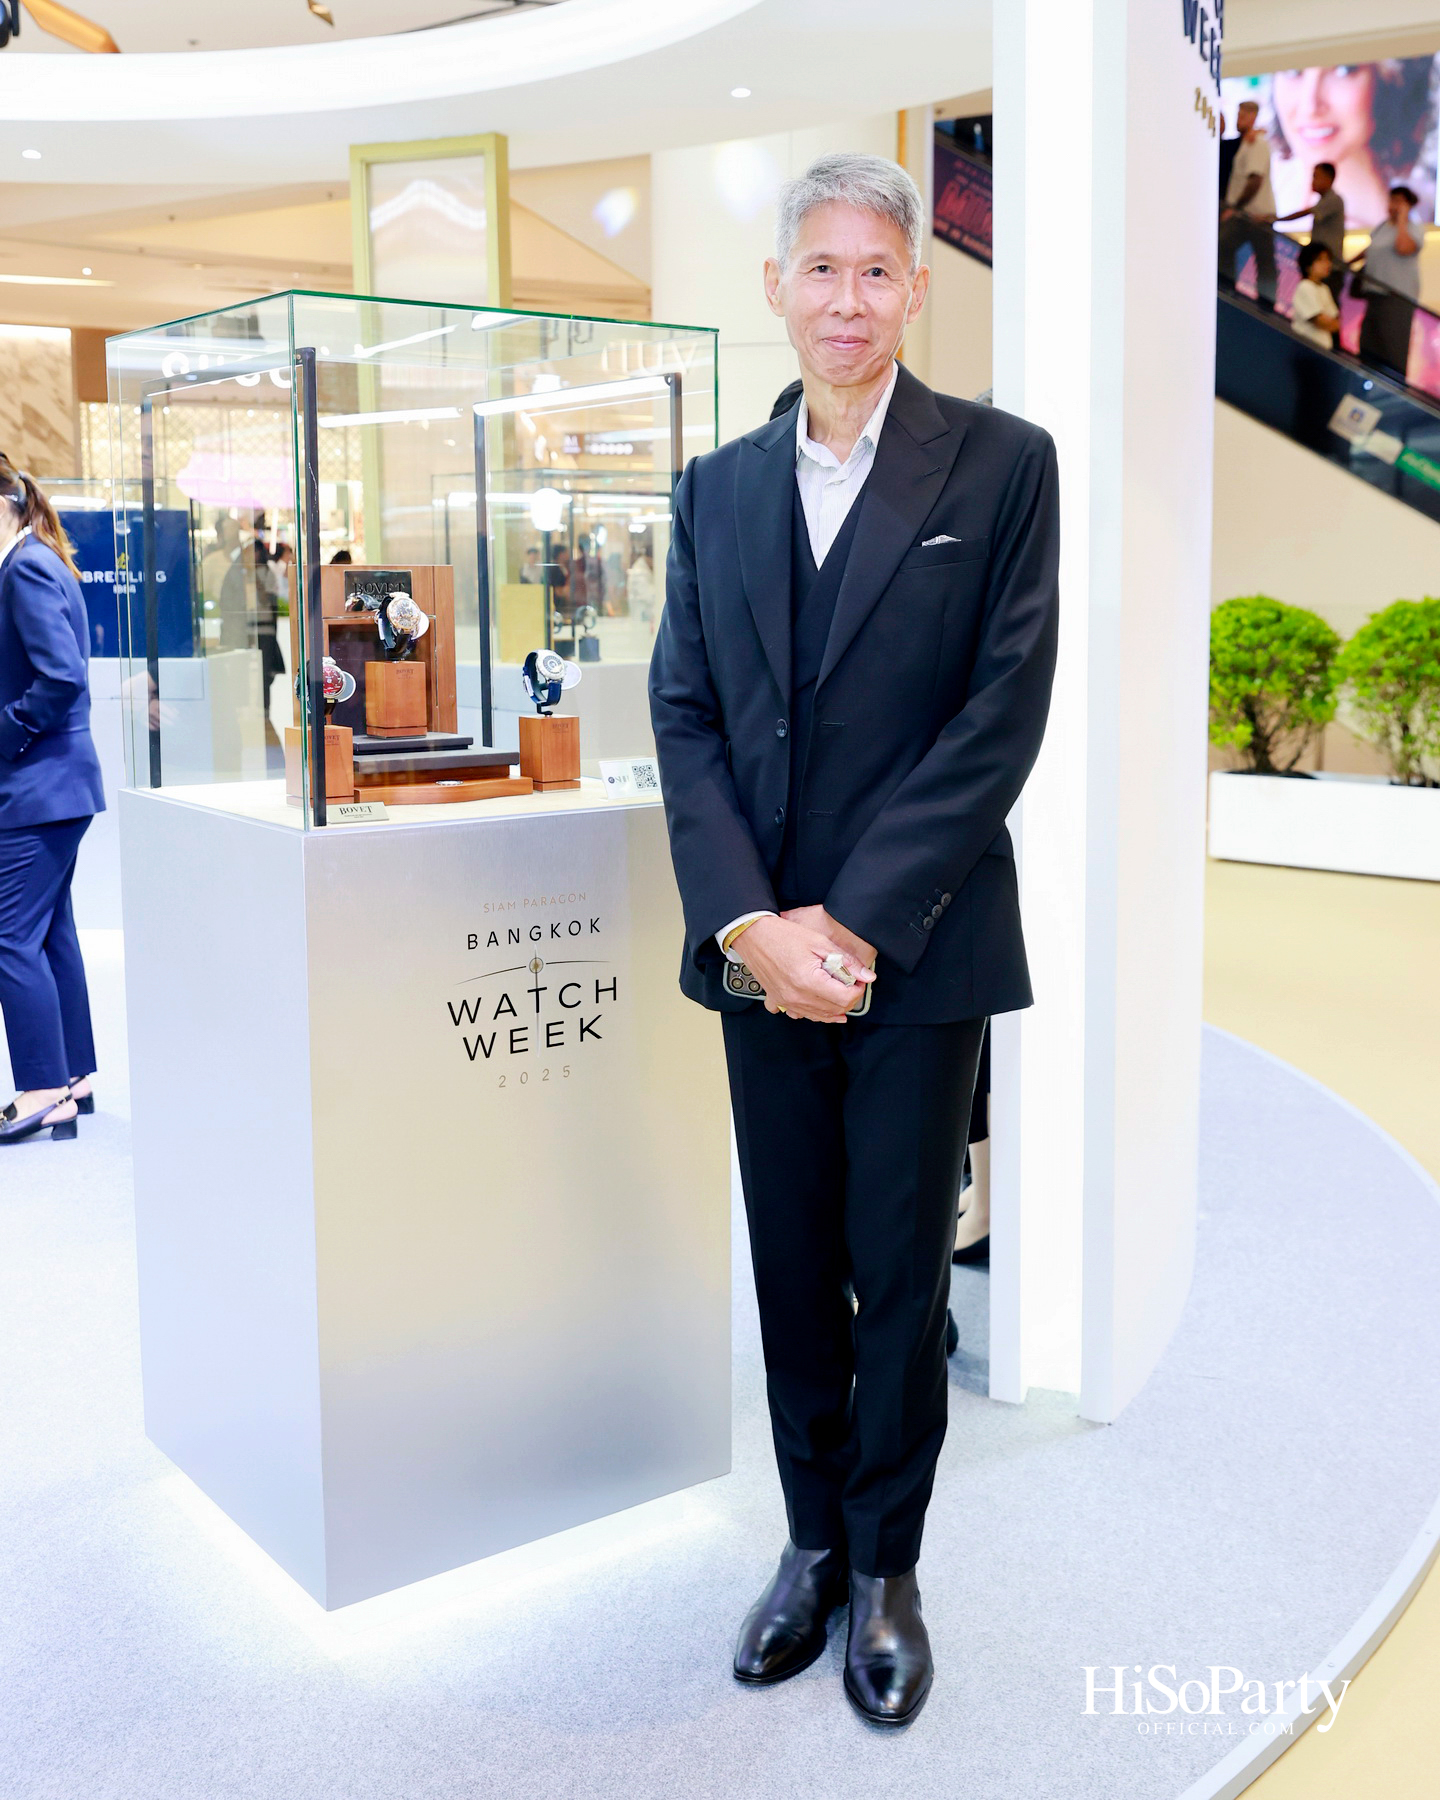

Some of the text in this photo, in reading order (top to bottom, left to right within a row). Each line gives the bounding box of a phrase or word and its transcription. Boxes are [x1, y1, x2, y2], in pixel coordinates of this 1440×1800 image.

[82, 570, 167, 583] BREITLIG
[352, 582, 406, 595] BOVET
[339, 806, 373, 815] BOVET
[483, 892, 587, 914] SIAM PARAGON
[467, 917, 601, 950] BANGKOK
[447, 976, 617, 1027] WATCH
[463, 1014, 603, 1062] WEEK
[498, 1065, 571, 1088] 2025
